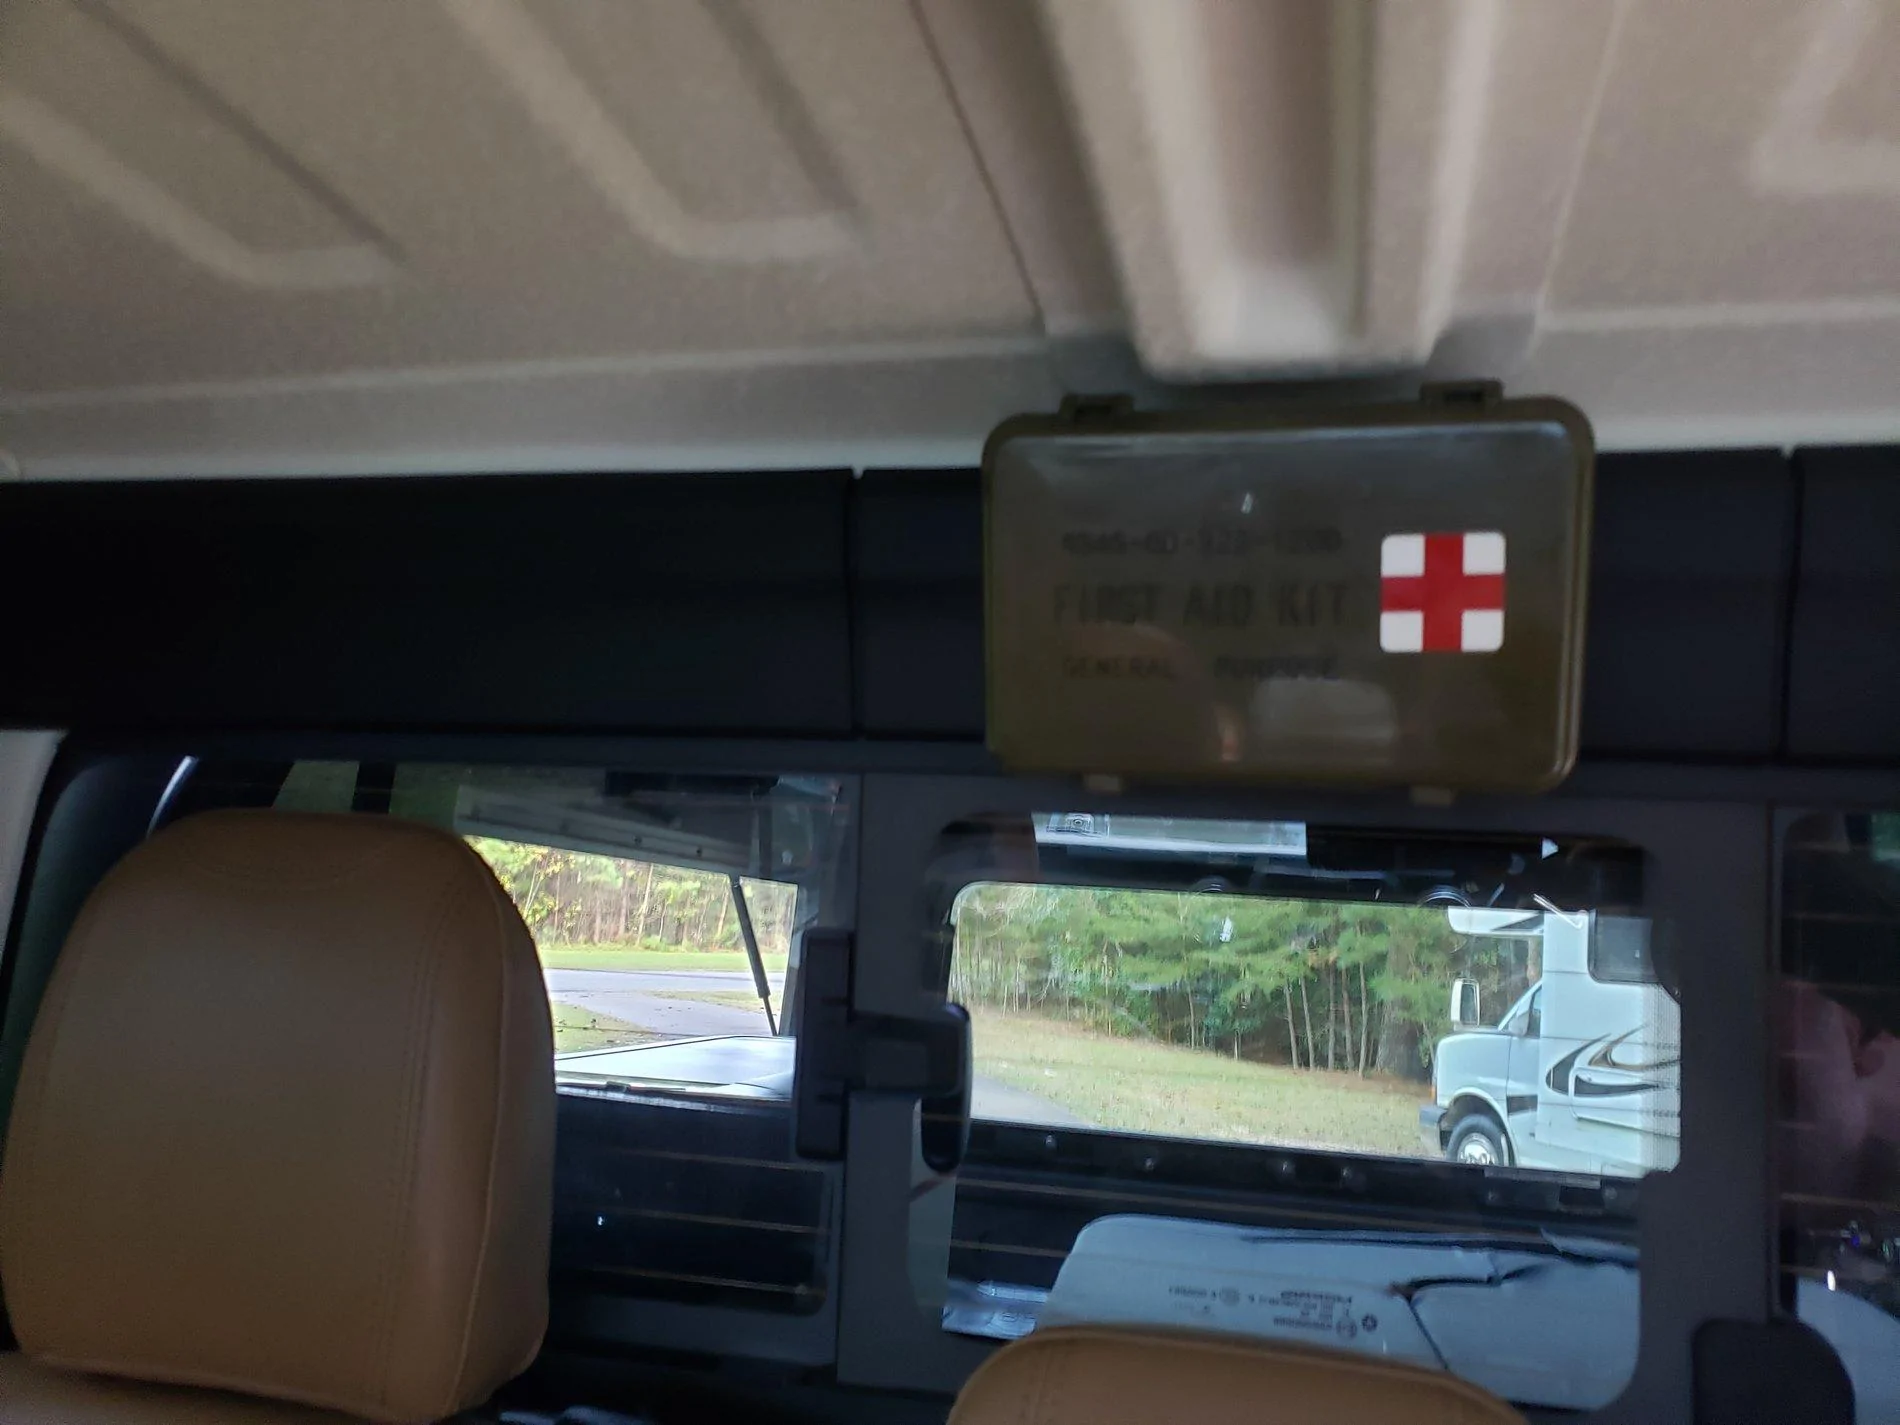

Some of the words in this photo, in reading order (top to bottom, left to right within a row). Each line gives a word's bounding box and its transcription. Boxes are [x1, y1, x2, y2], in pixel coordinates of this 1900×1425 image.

[1053, 581, 1159, 625] FIRST
[1183, 582, 1255, 626] AID
[1276, 580, 1349, 626] KIT
[1063, 654, 1179, 681] GENERAL
